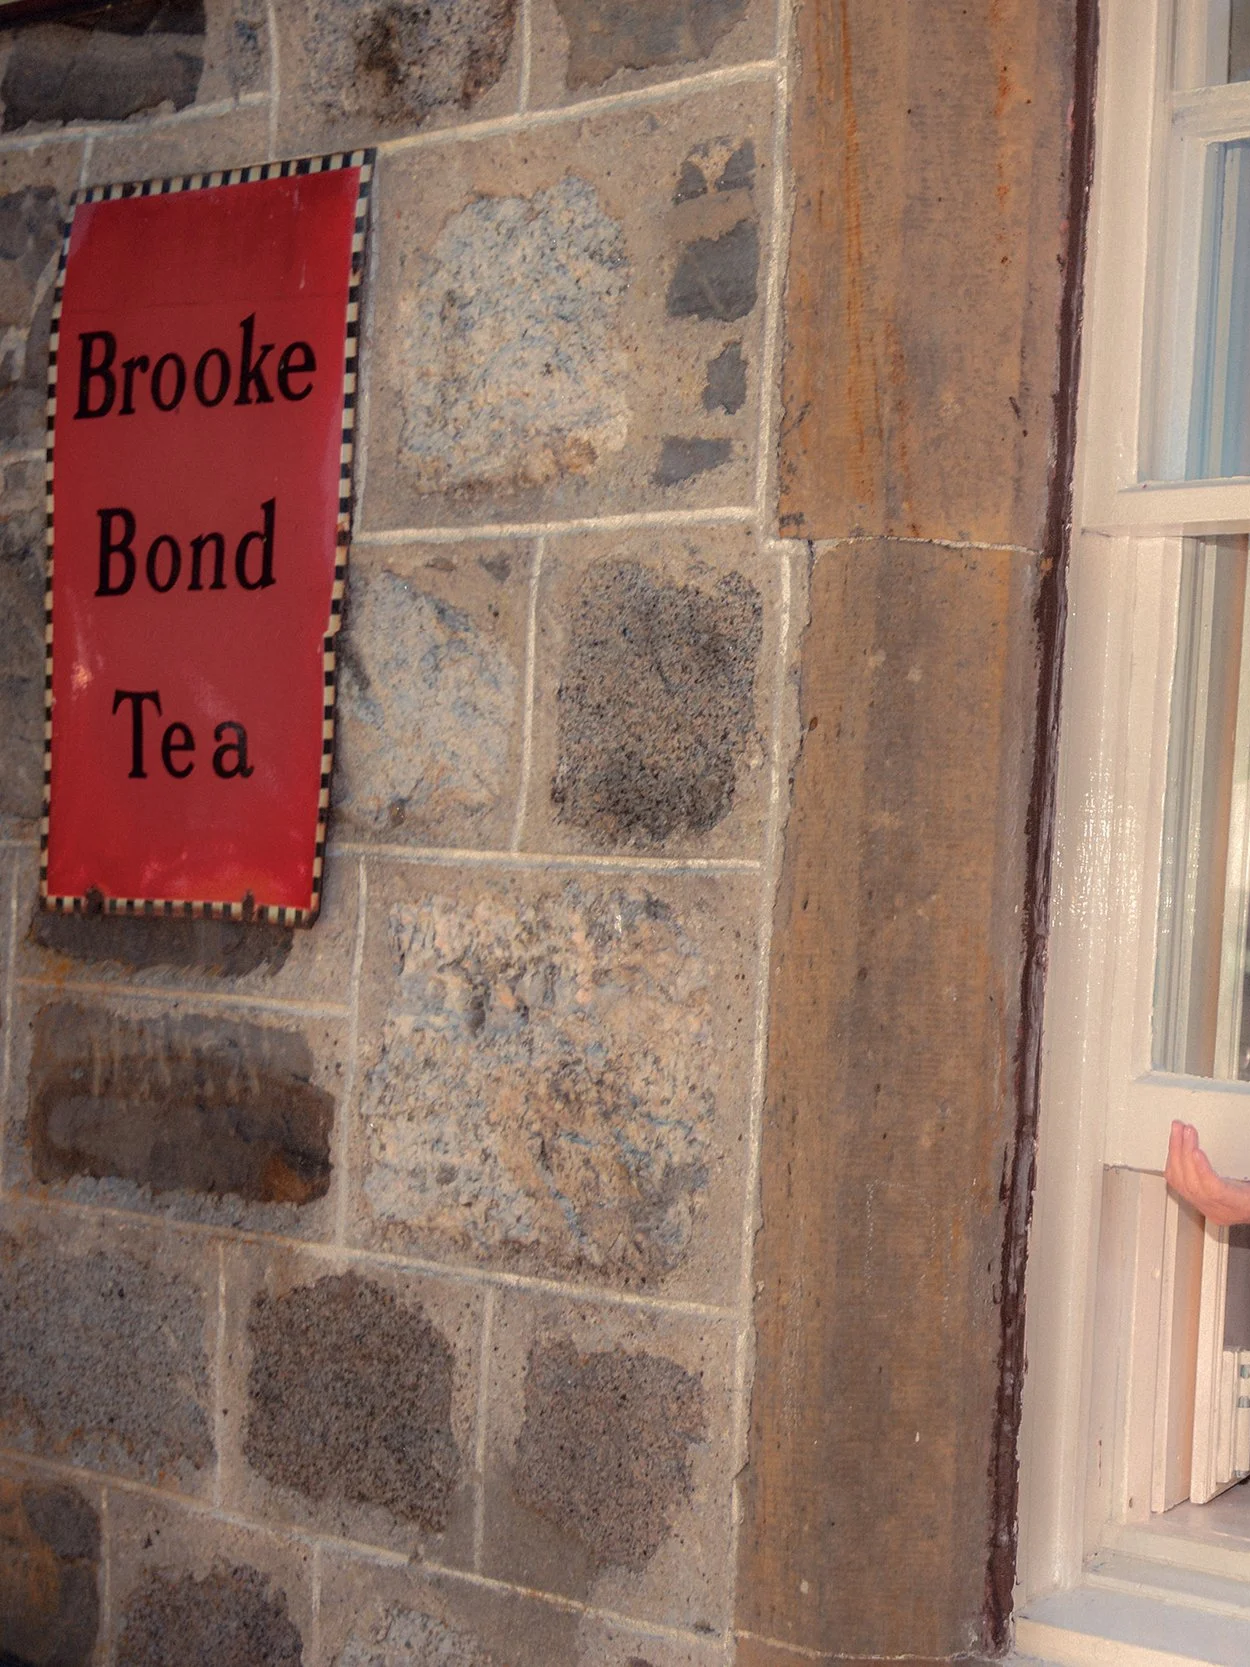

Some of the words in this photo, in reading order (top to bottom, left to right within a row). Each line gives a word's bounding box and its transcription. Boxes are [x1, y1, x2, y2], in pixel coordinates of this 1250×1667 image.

[72, 312, 317, 420] Brooke
[94, 498, 276, 597] Bond
[112, 690, 255, 779] Tea
